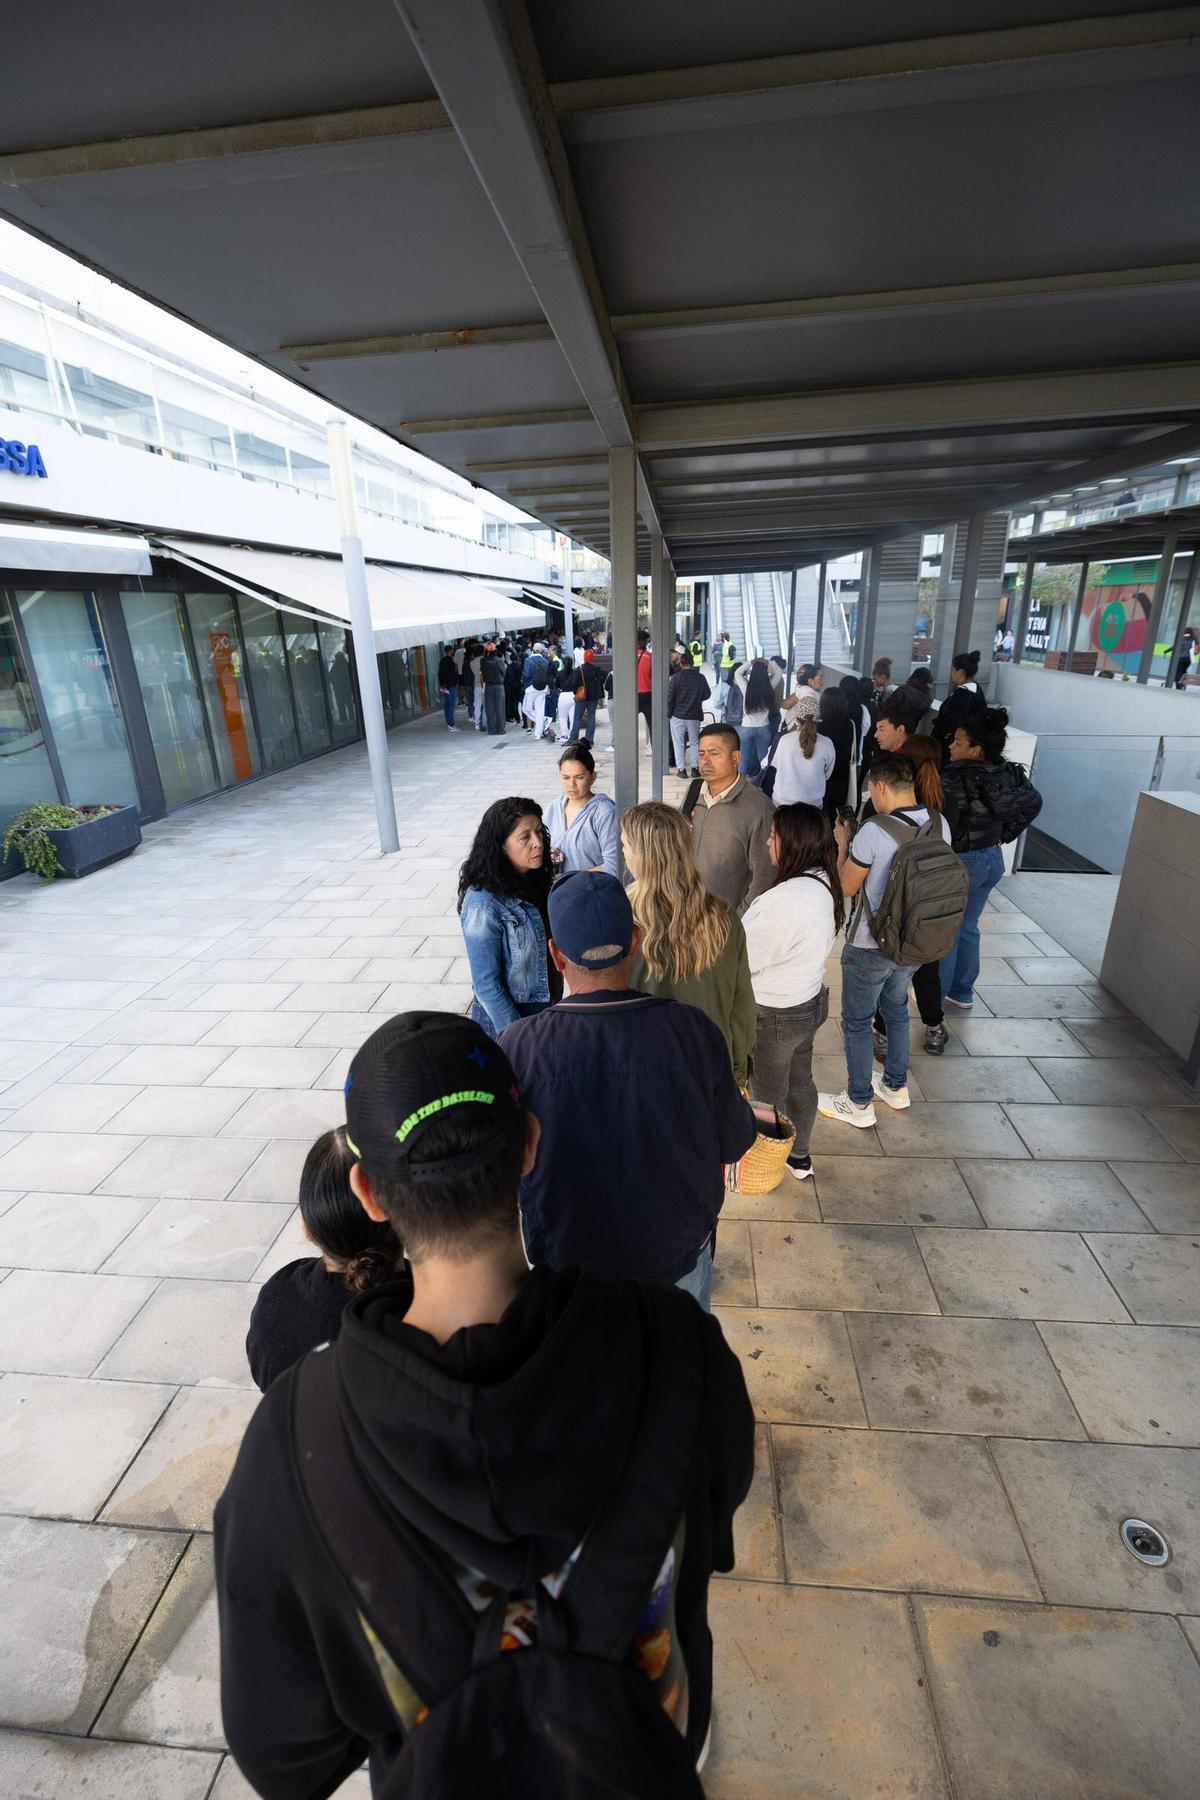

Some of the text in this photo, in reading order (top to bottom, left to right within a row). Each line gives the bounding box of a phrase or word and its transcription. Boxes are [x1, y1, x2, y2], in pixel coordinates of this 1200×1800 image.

[1028, 617, 1047, 631] TEVA
[1025, 634, 1050, 649] SALUT
[417, 1100, 442, 1120] THE
